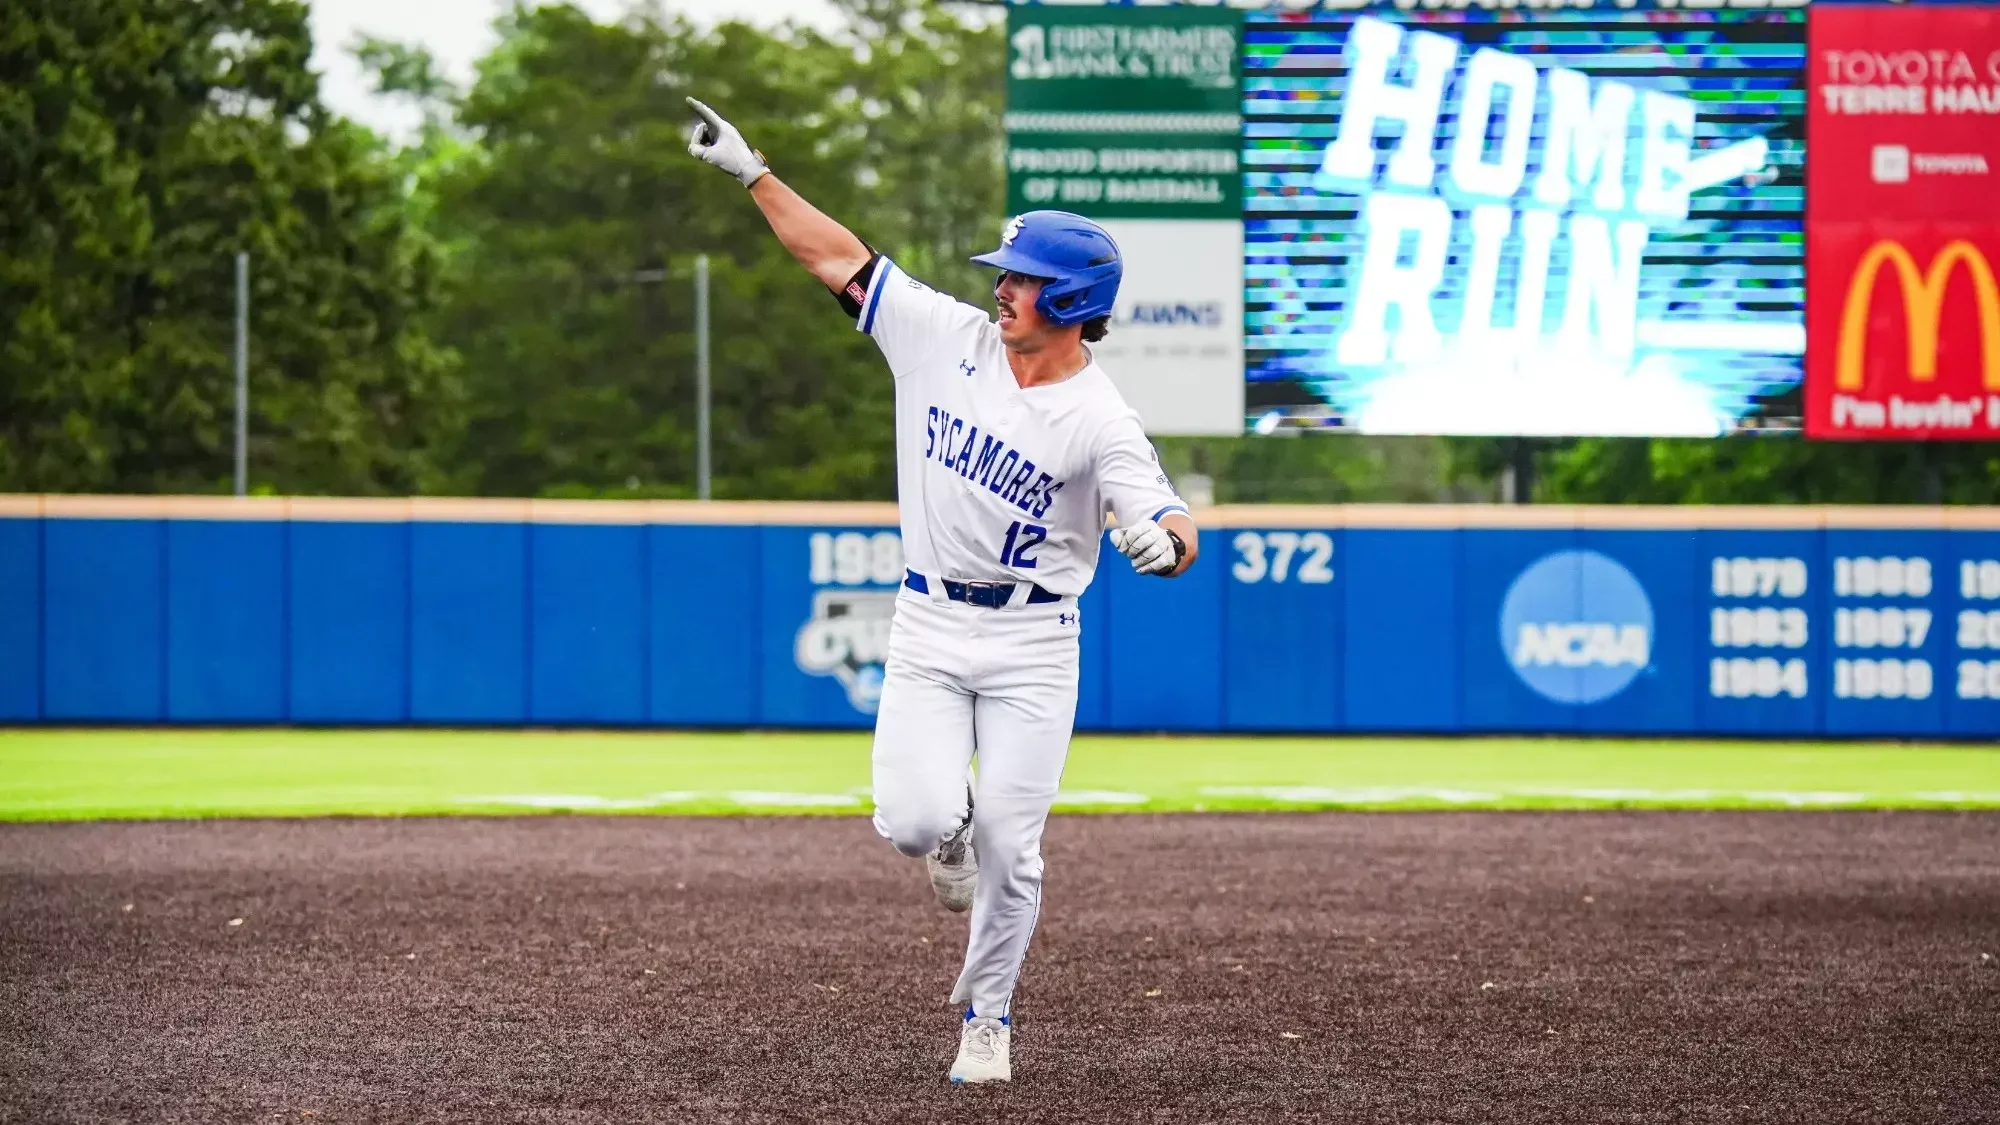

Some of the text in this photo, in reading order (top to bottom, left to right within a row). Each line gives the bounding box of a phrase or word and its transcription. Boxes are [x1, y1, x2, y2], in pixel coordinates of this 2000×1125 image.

[1051, 25, 1235, 53] FIRST FARMERS
[1052, 52, 1233, 77] BANK & TRUST
[1823, 50, 1976, 83] TOYOTA
[1322, 15, 1696, 220] HOME
[1819, 84, 2000, 114] TERRE HAU
[1009, 149, 1238, 173] PROUD SUPPORTER
[1912, 153, 1989, 174] TOYOTA
[1022, 178, 1226, 203] OF ISU BASEBALL
[1336, 192, 1648, 366] RUN
[1832, 394, 1886, 429] I'm
[1889, 394, 1982, 429] lovin'
[926, 406, 1065, 519] SYCAMORES
[809, 532, 902, 585] 198
[1000, 520, 1047, 569] 12
[1232, 532, 1334, 584] 372
[1711, 556, 1807, 597] 1979
[1834, 556, 1932, 597] 1986
[1514, 622, 1650, 670] NCAA
[1710, 606, 1808, 648] 1983
[1834, 606, 1932, 648] 1987
[1710, 657, 1808, 698] 1984
